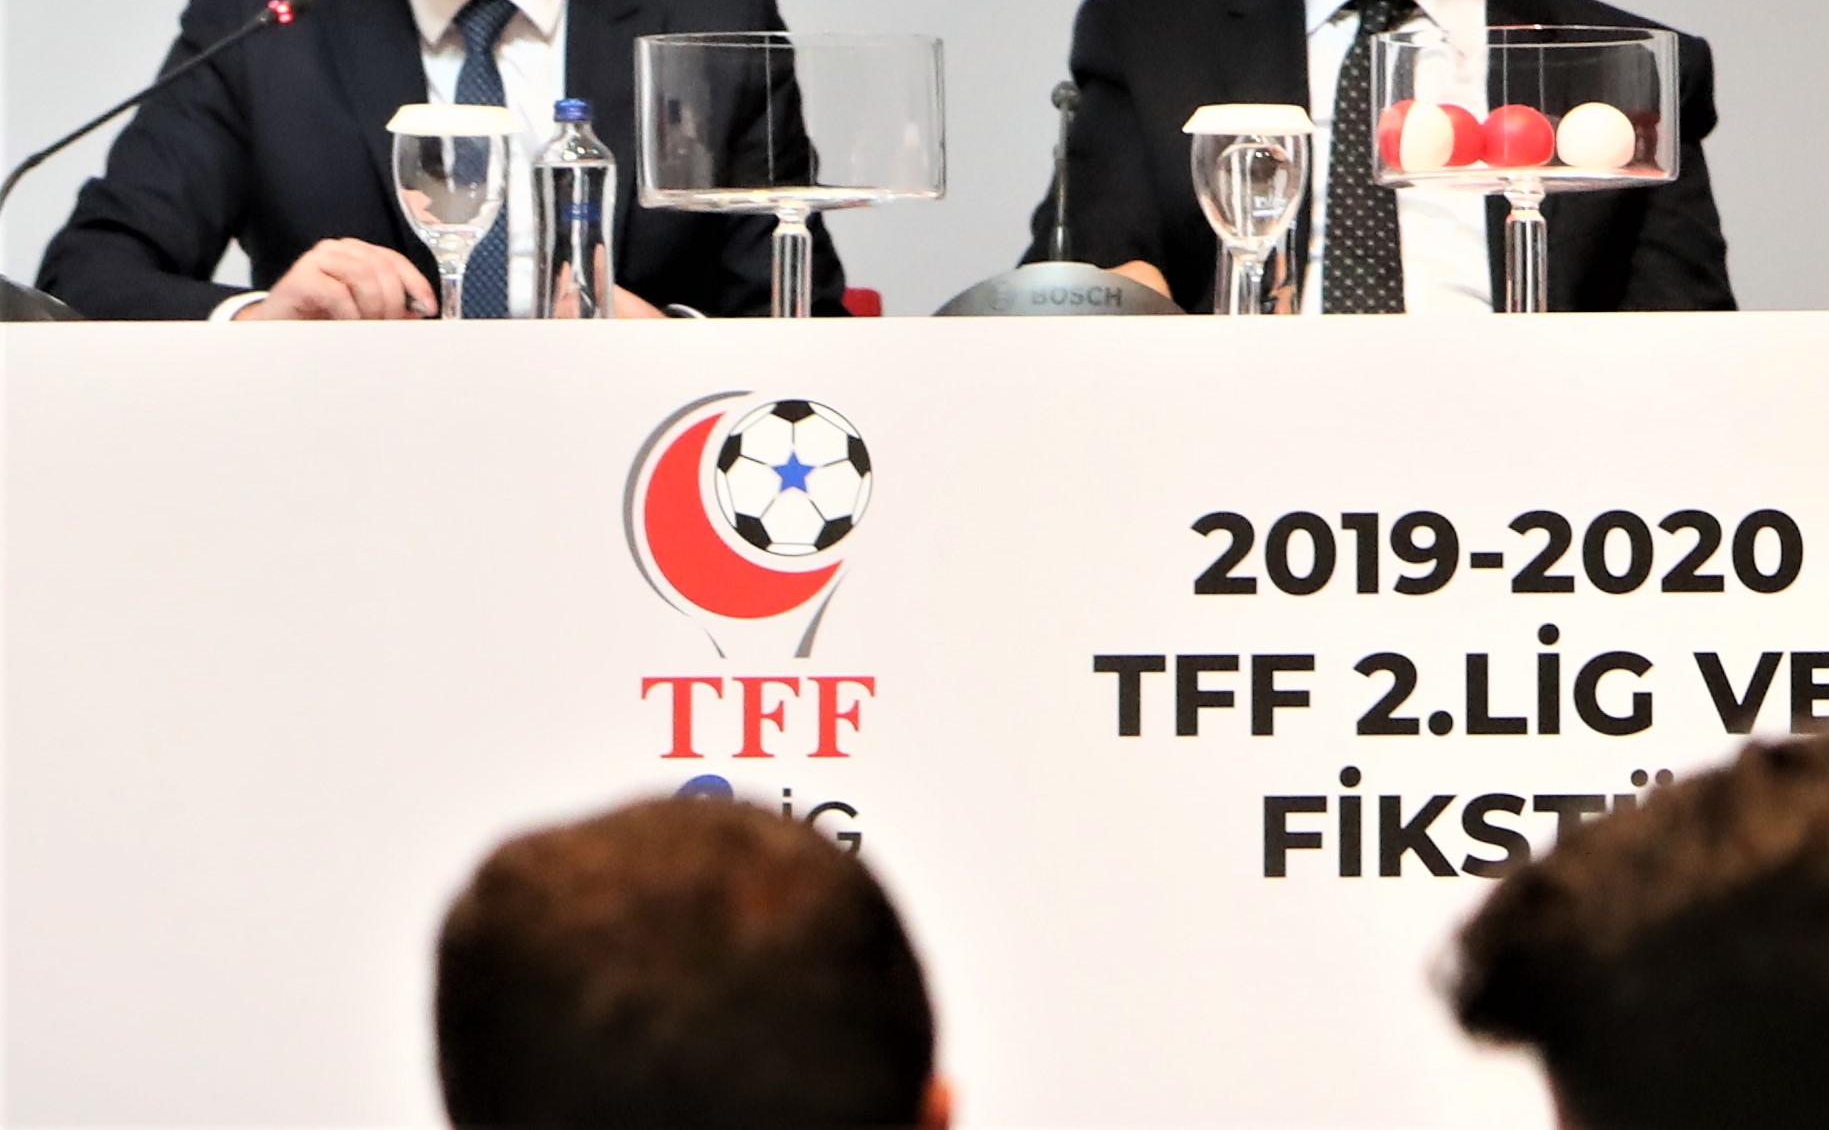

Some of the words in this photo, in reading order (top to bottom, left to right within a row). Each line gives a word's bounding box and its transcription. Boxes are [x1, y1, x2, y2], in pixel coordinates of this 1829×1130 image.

[1031, 286, 1123, 307] BOSCH
[1190, 509, 1804, 596] 2019-2020
[641, 676, 876, 759] TFF
[1092, 654, 1316, 737] TFF
[1353, 622, 1655, 737] 2.LİG
